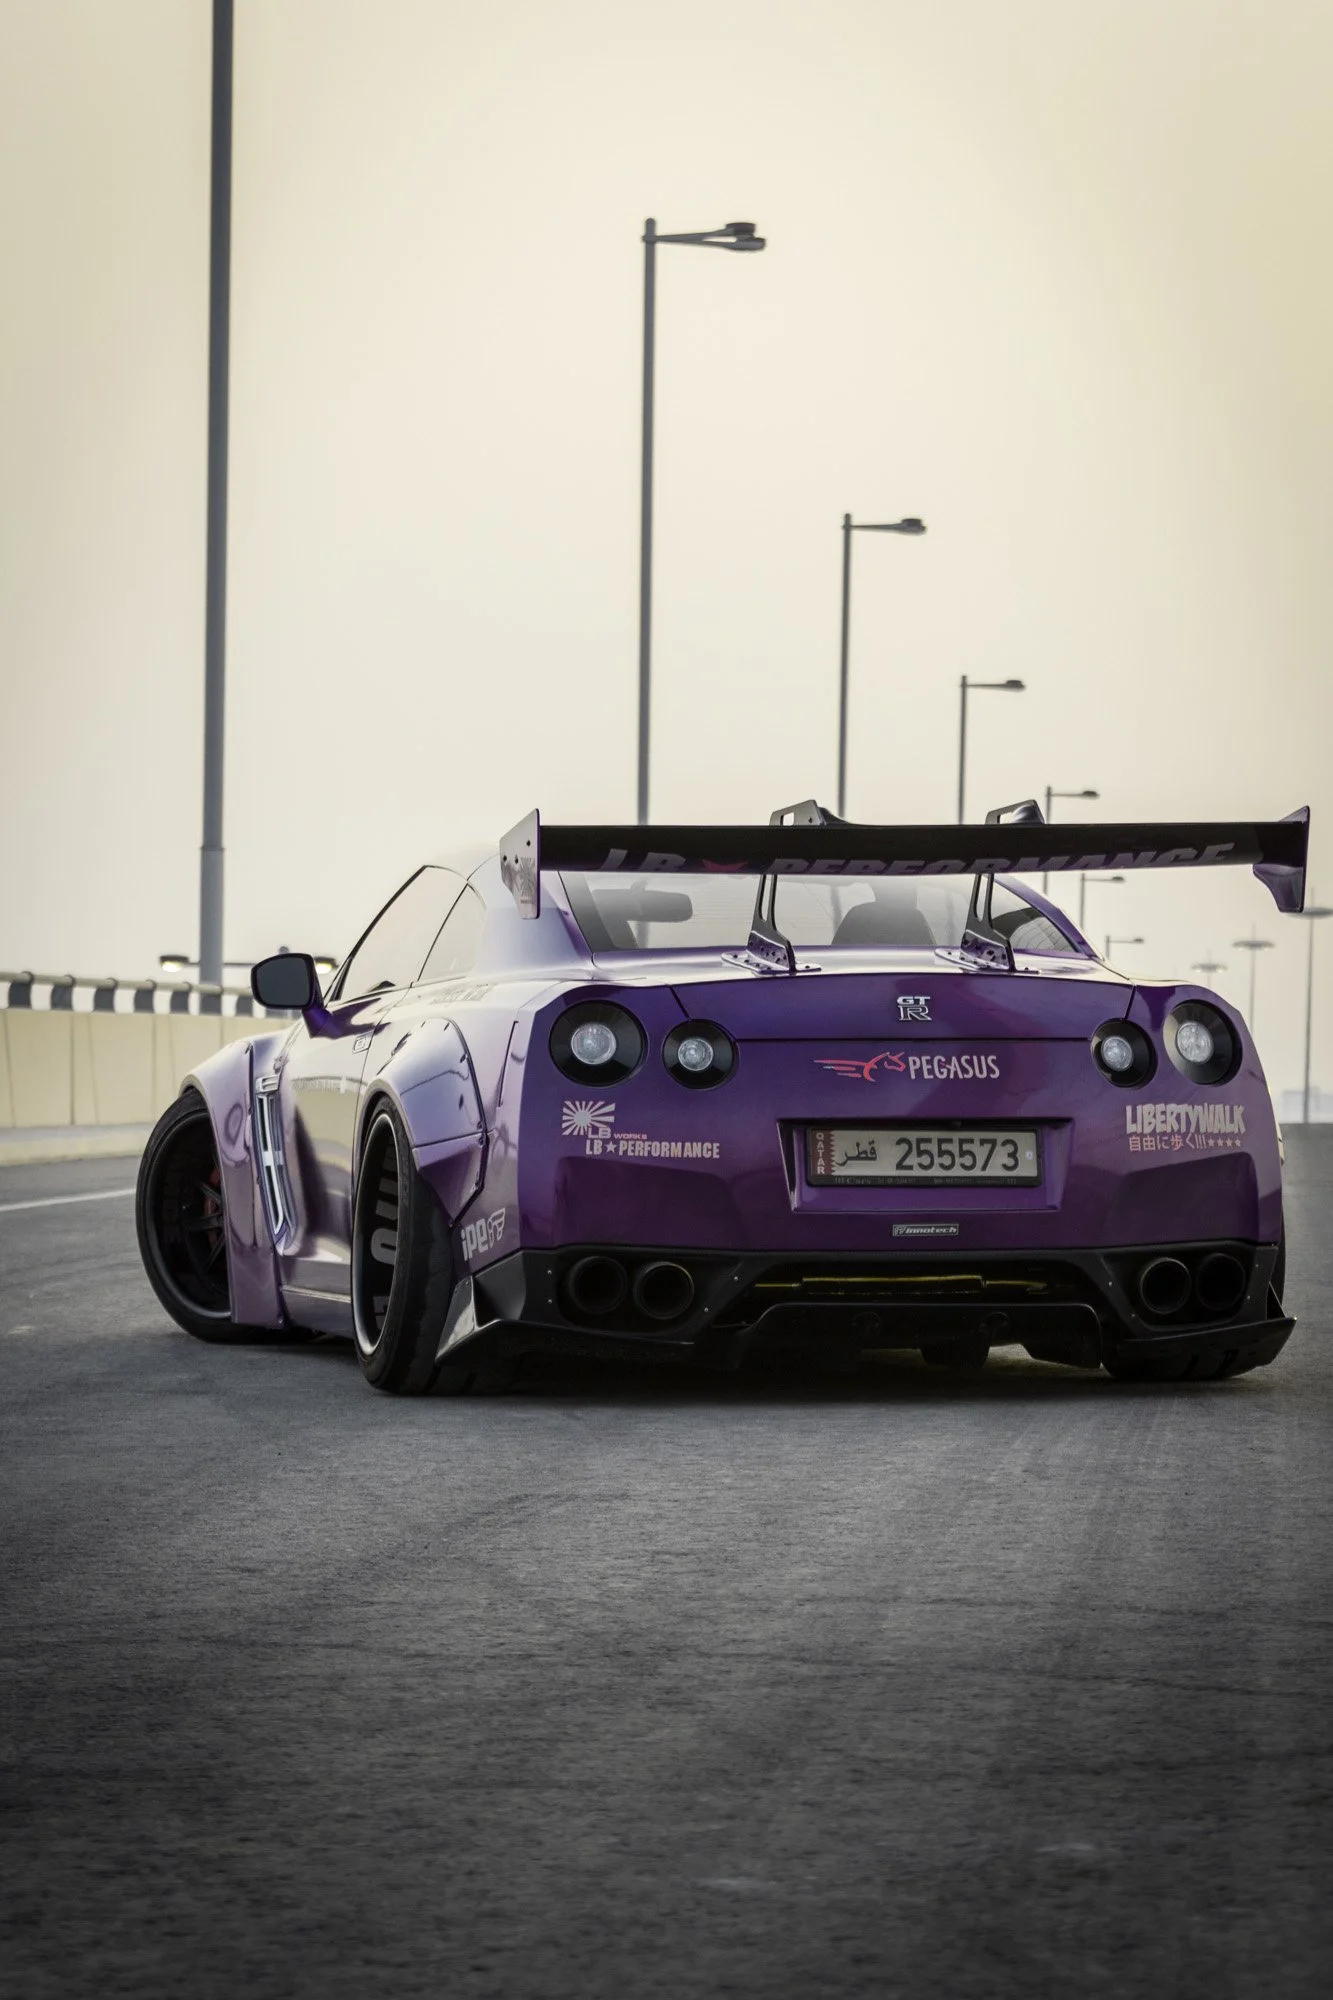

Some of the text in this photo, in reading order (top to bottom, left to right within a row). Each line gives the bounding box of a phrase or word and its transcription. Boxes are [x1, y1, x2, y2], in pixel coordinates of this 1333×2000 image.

[909, 1055, 1000, 1079] PEGASUS
[1126, 1103, 1246, 1134] LIBERTYWALK
[588, 1127, 611, 1138] LB
[585, 1139, 720, 1158] LB PERFORMANCE
[815, 1131, 826, 1175] QATAR
[836, 1139, 877, 1166] قطر
[895, 1138, 1019, 1172] 255573
